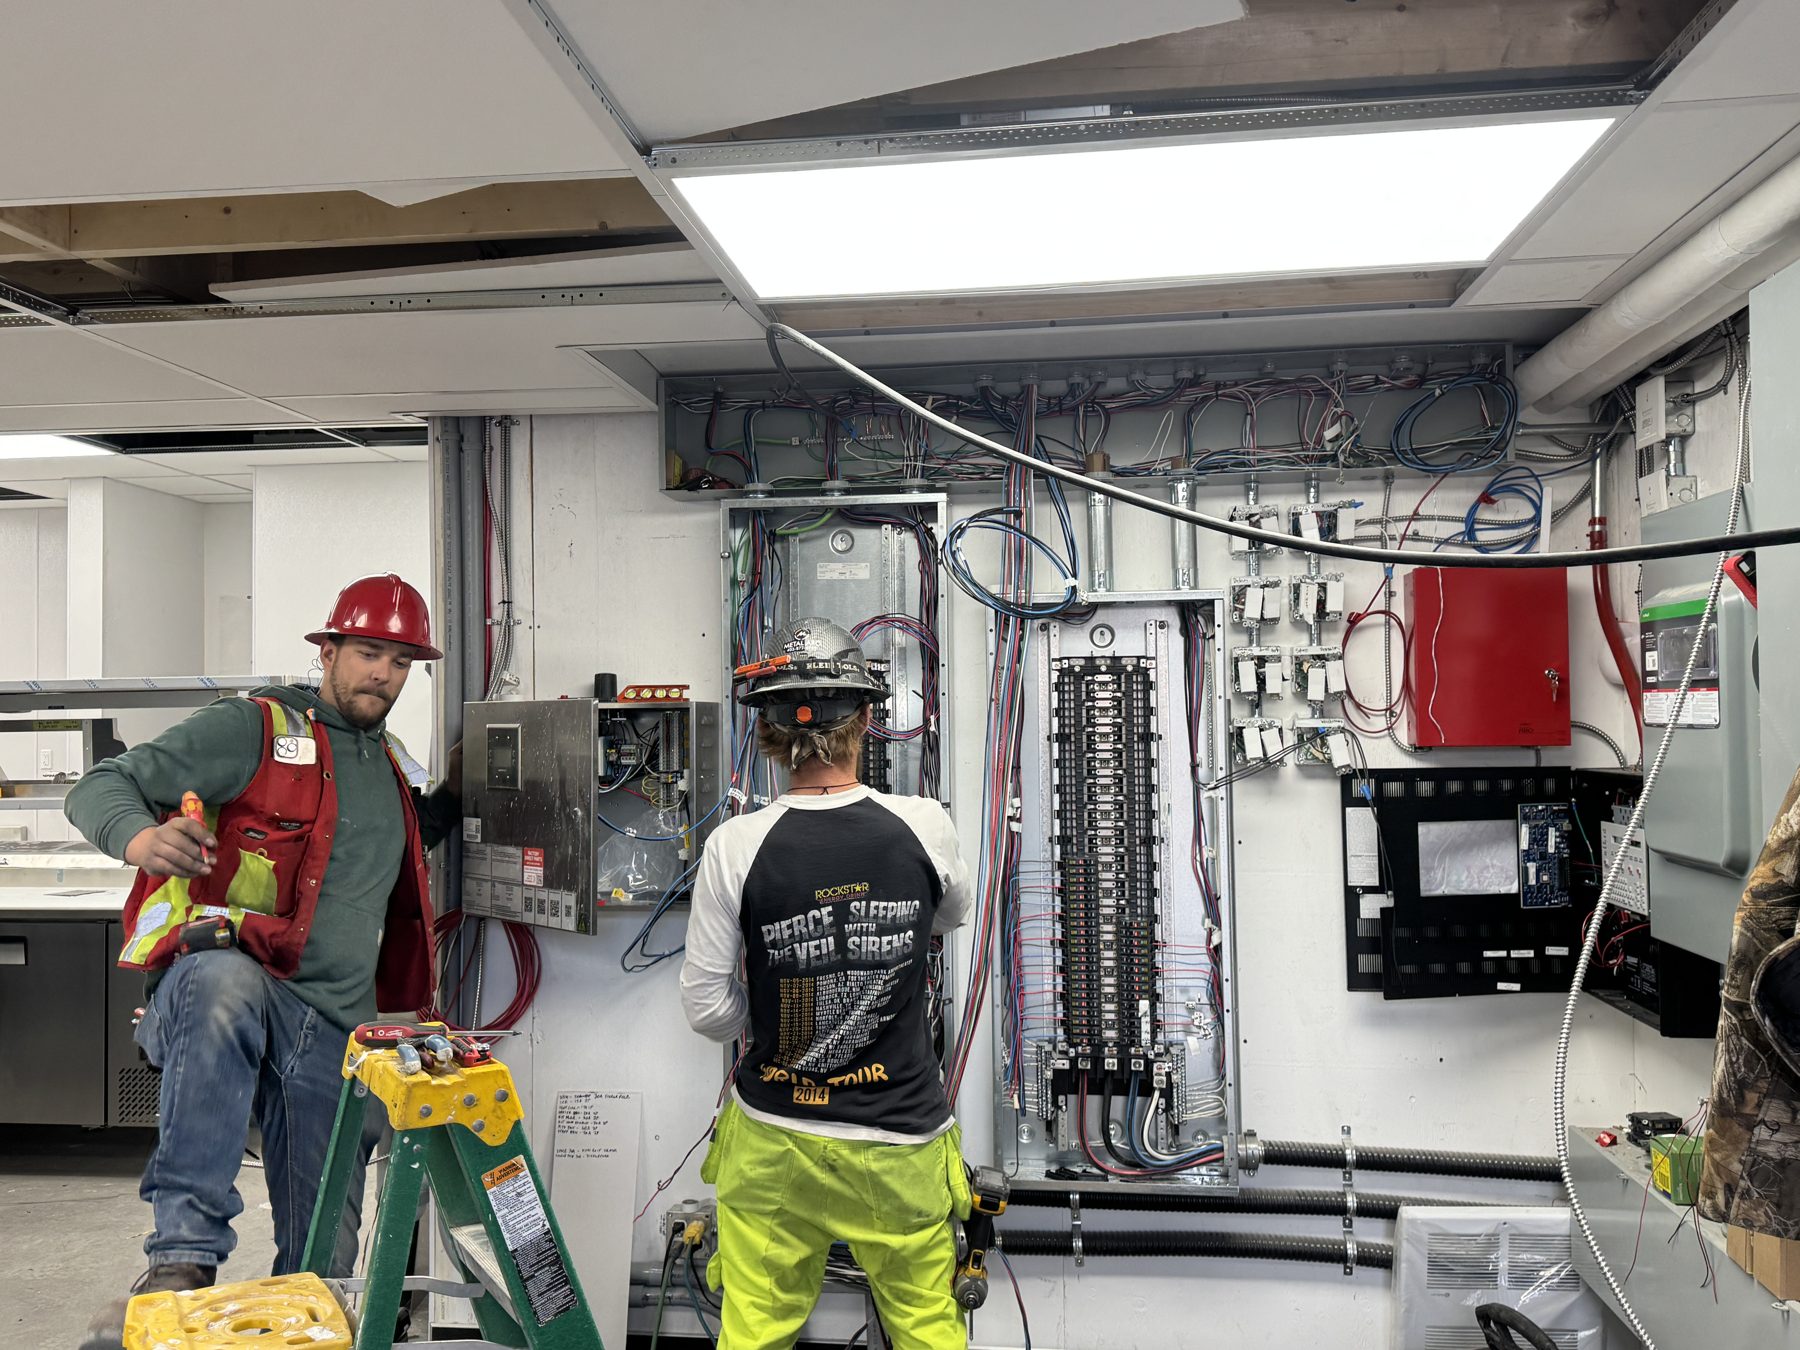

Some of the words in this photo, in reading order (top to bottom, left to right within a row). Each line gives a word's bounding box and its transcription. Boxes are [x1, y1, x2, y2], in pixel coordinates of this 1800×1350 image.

[849, 900, 920, 924] SLEEPING
[761, 905, 836, 948] PIERCE
[844, 922, 876, 937] WITH
[767, 945, 794, 967] THE
[793, 935, 841, 969] VEIL
[847, 930, 914, 960] SIRENS
[795, 1088, 826, 1102] 2014
